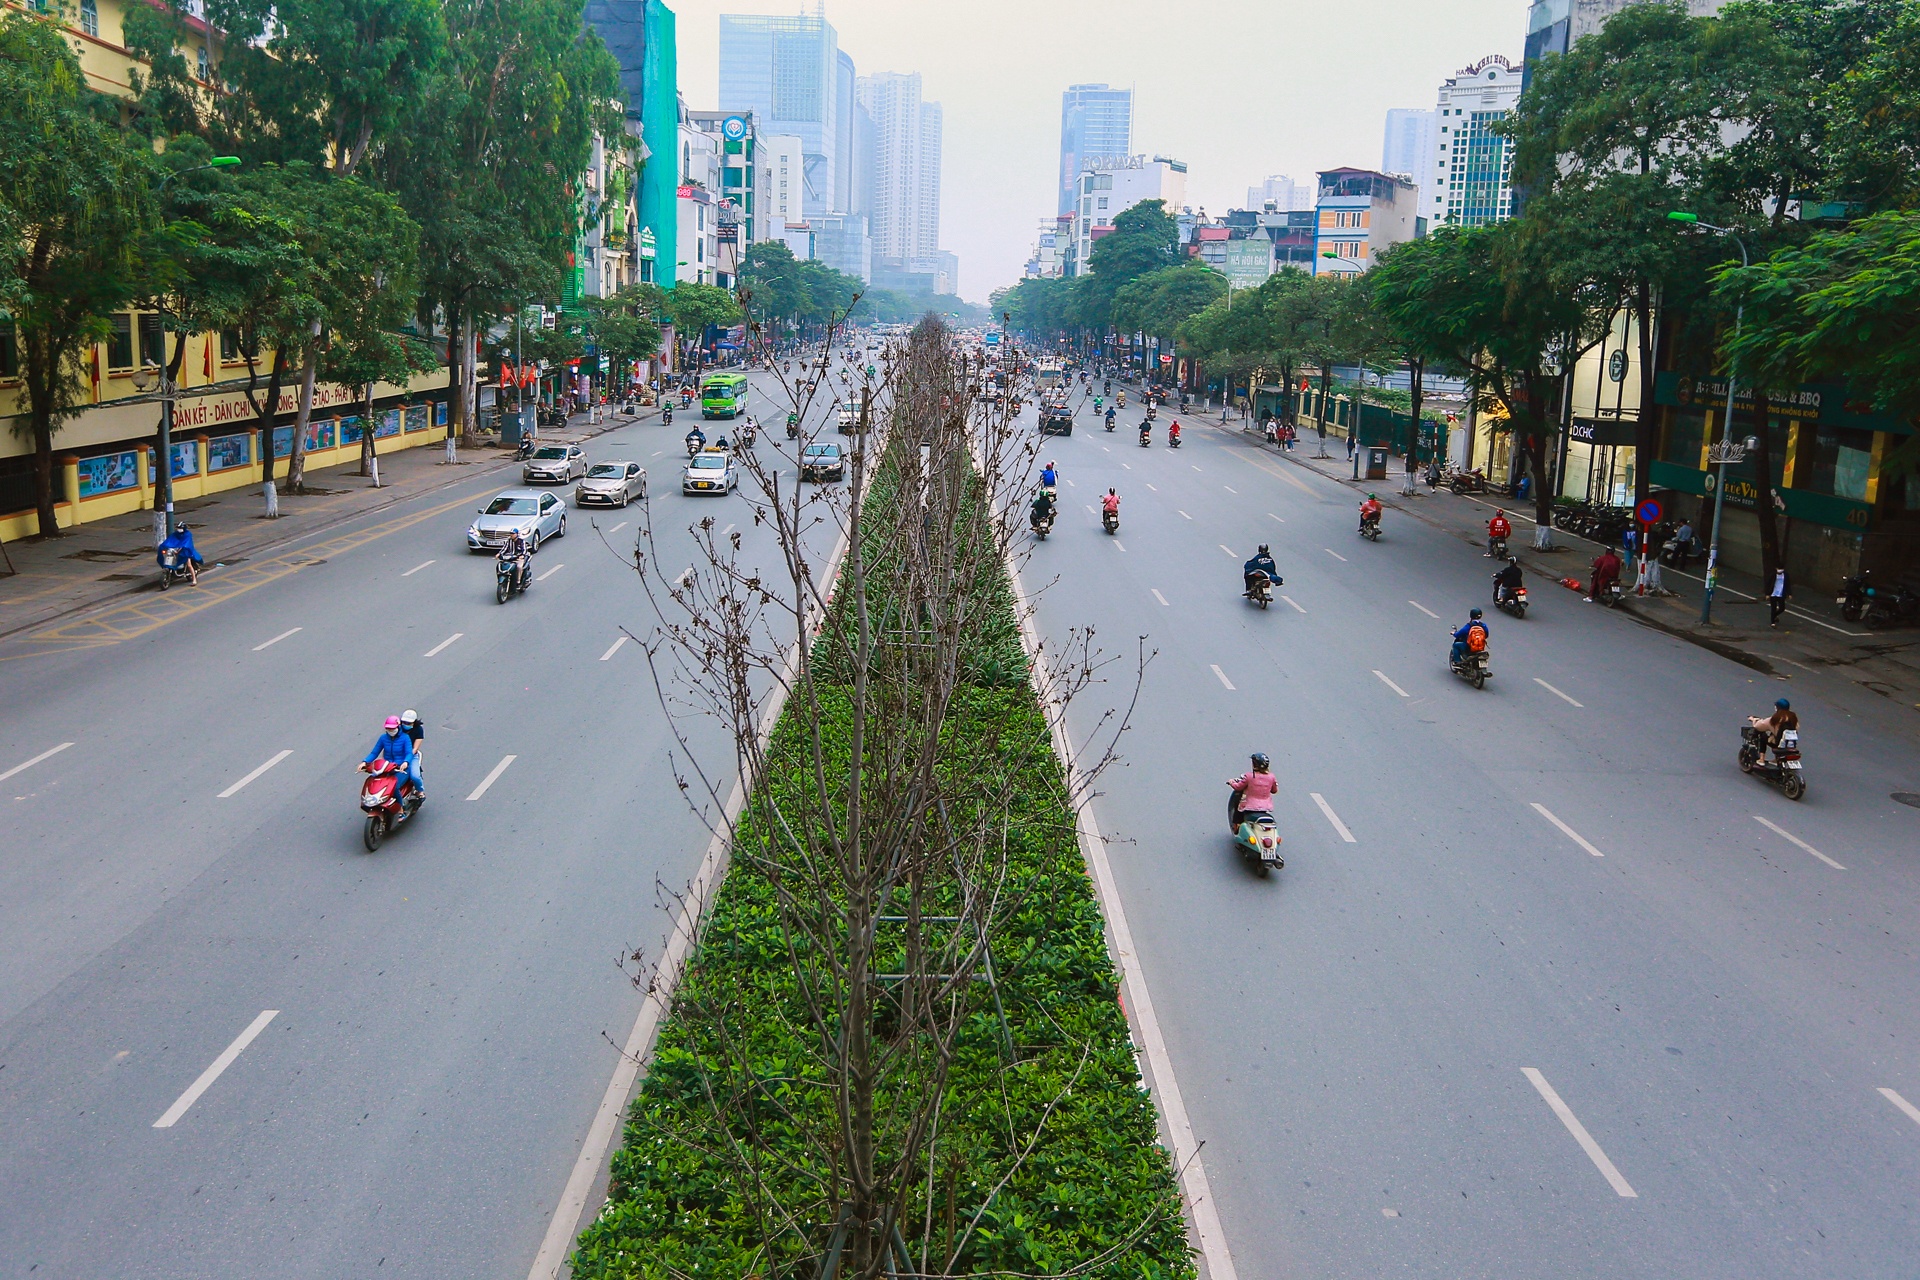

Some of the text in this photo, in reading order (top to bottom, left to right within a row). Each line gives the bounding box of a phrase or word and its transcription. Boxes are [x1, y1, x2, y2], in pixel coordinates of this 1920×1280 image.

[1799, 391, 1820, 407] BBQ
[193, 397, 207, 424] KẾT
[214, 399, 232, 421] DÂN
[1846, 508, 1868, 528] 40
